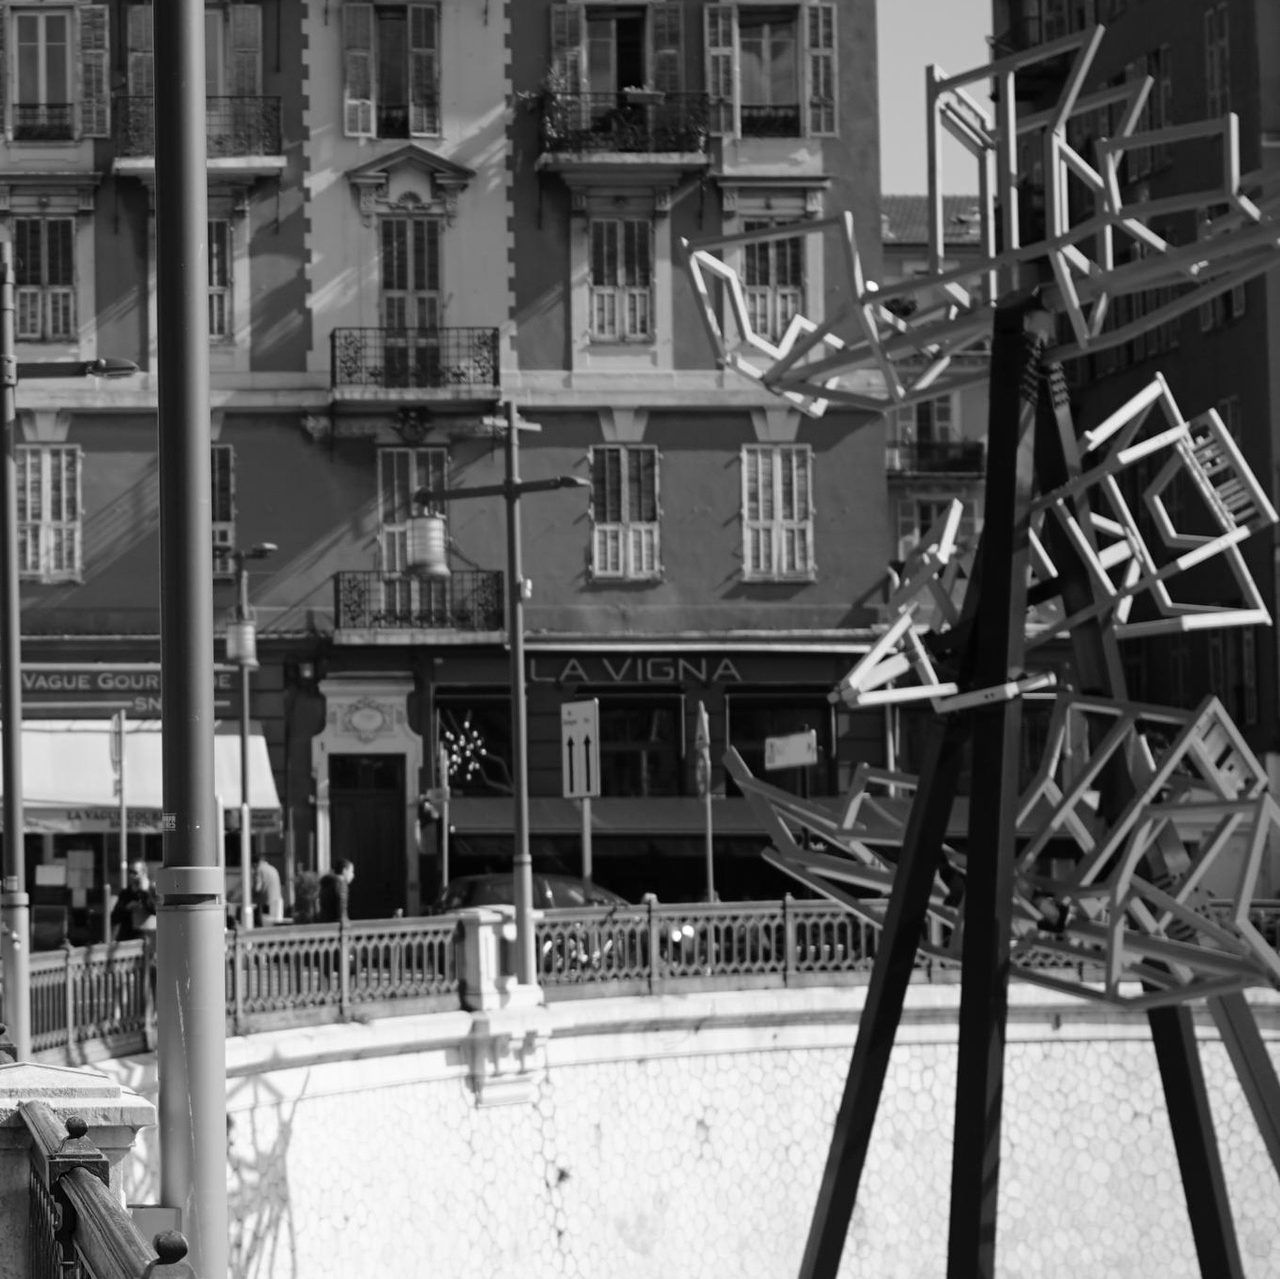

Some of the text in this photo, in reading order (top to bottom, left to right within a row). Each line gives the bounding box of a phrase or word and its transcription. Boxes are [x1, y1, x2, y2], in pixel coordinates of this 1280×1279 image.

[530, 657, 742, 681] LA VIGNA
[21, 673, 91, 690] VAGUE
